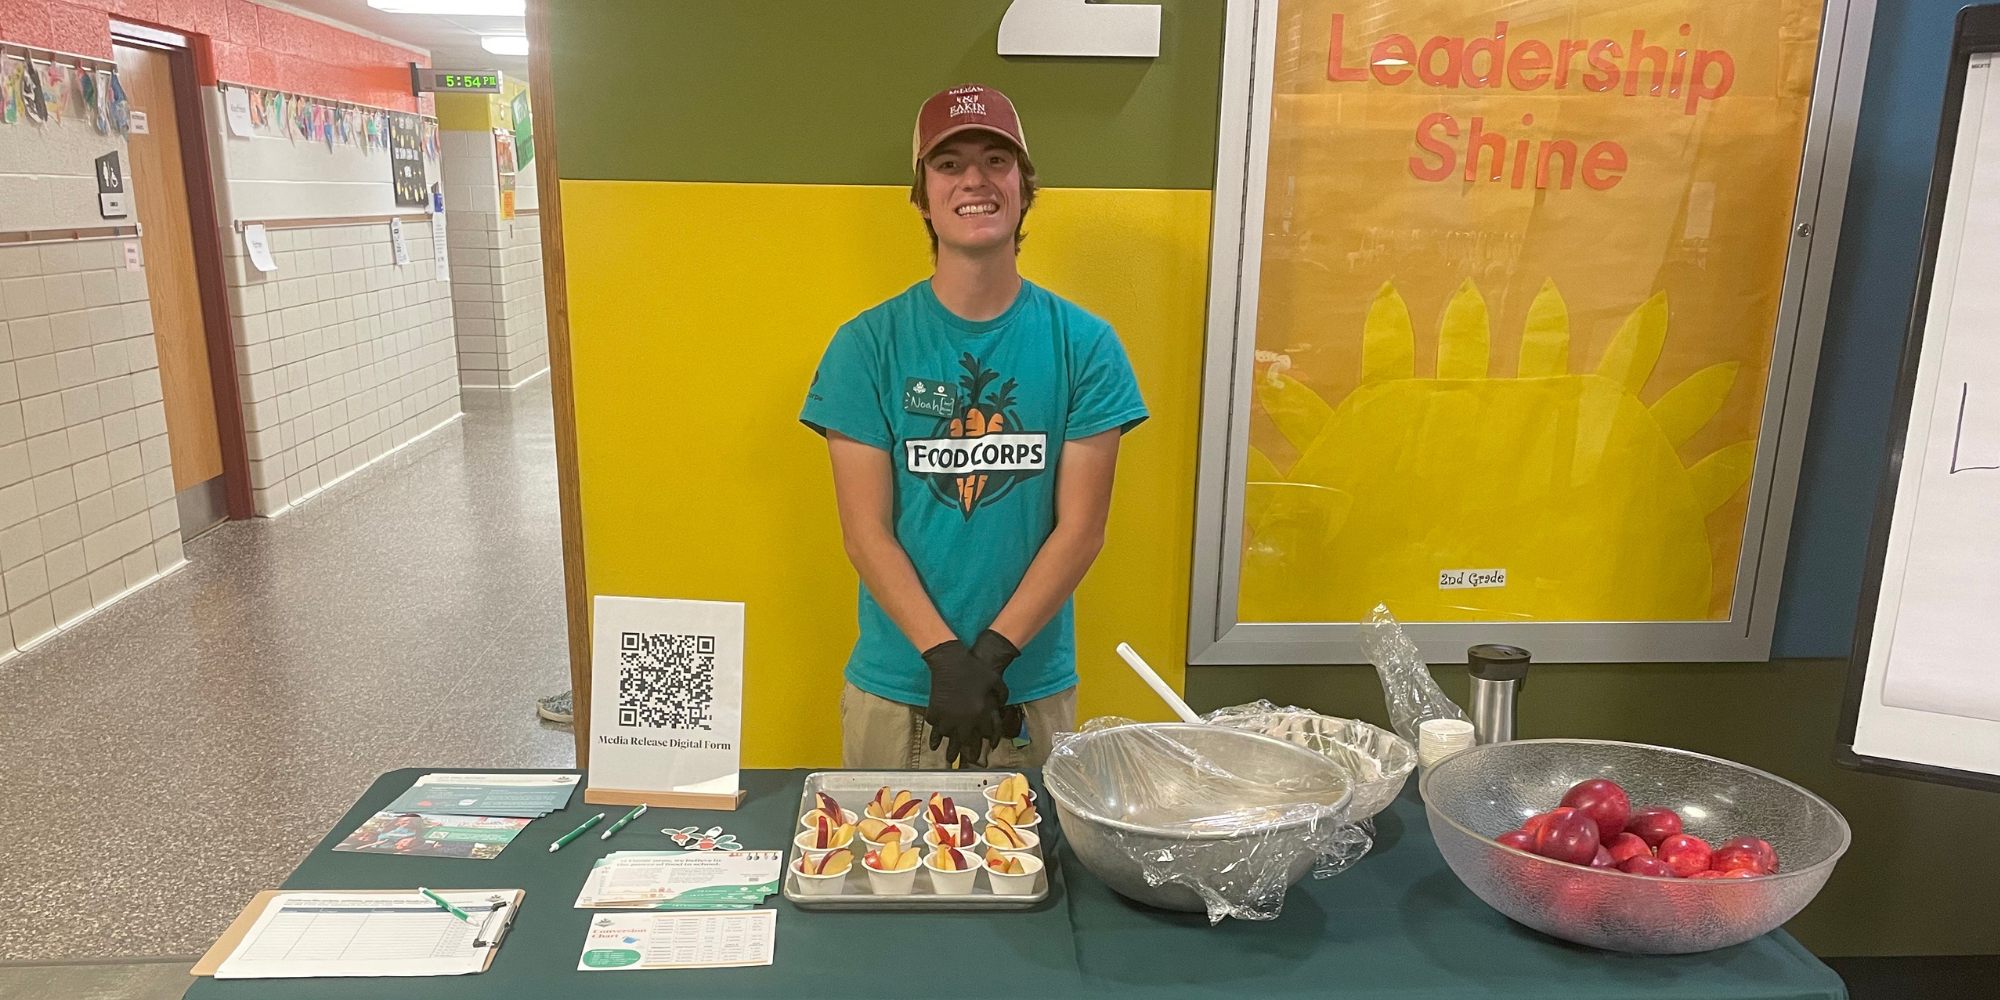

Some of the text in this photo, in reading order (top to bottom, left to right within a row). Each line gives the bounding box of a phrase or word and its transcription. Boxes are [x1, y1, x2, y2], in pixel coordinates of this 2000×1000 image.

[1328, 13, 1735, 115] Leadership
[446, 75, 481, 88] 5:54
[950, 103, 985, 114] EAKIN
[1409, 112, 1628, 191] Shine
[911, 396, 940, 412] Noah
[1440, 570, 1504, 587] 2nd Grade
[598, 735, 731, 750] Media Release Digital Form
